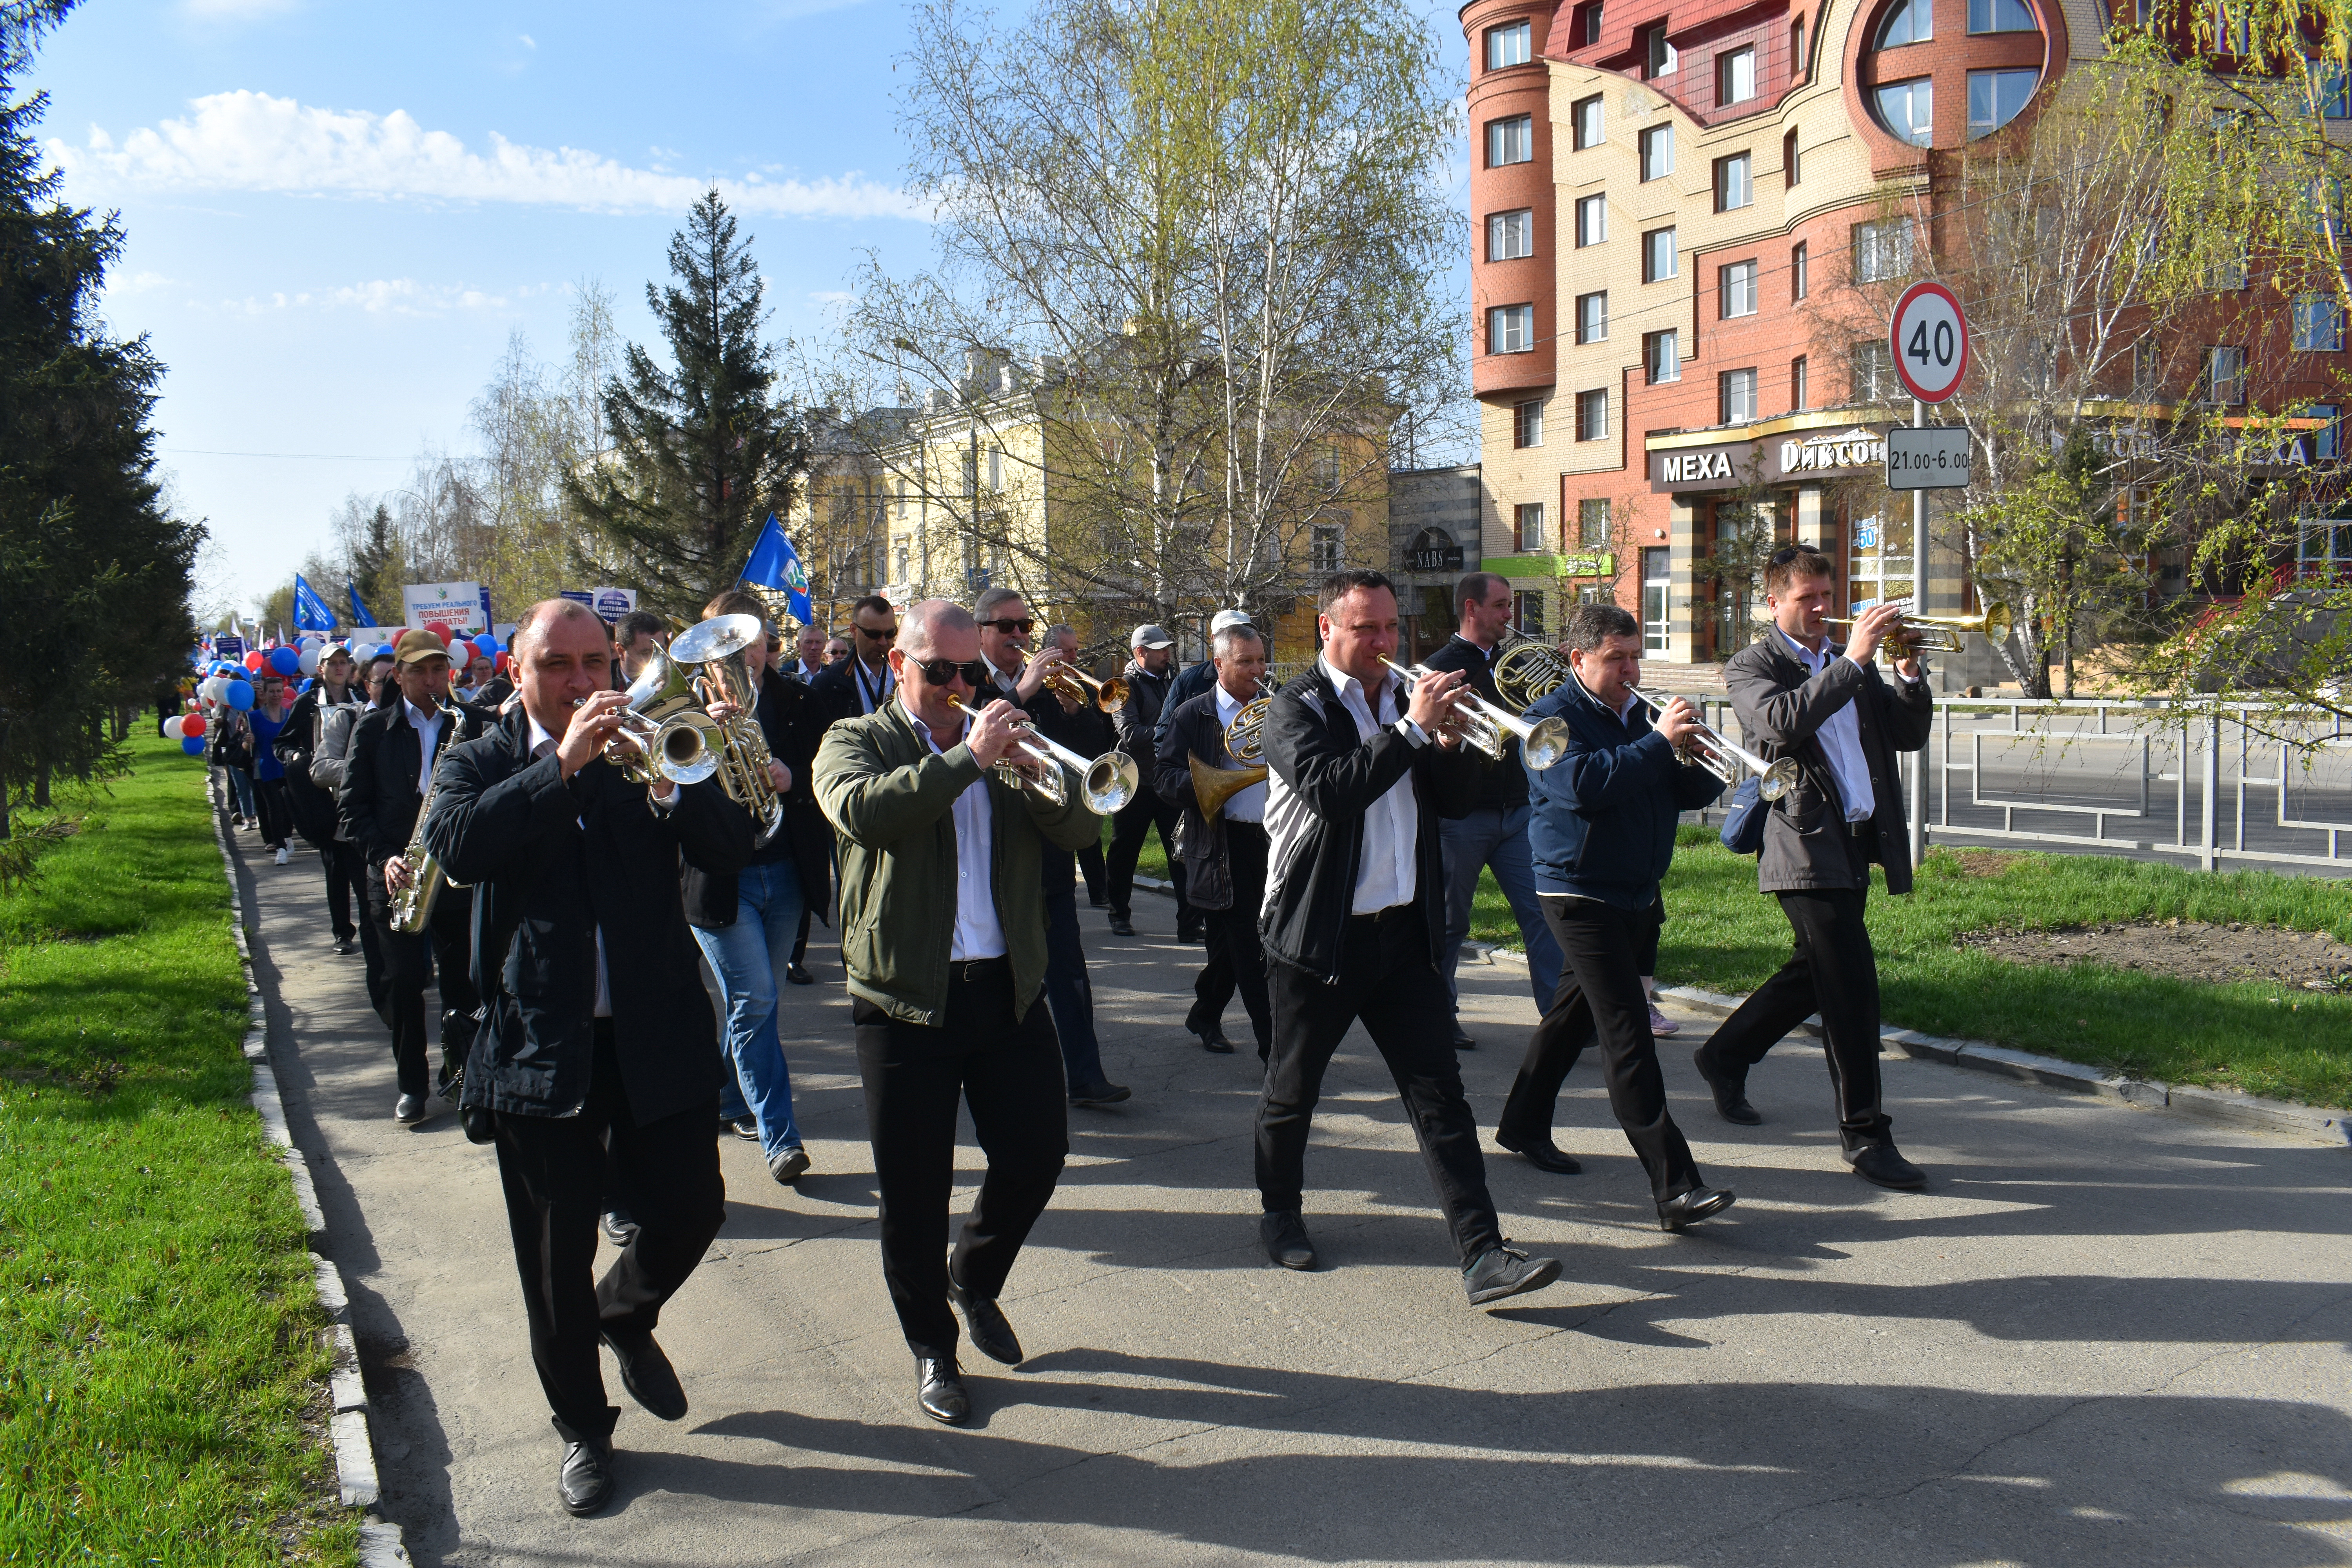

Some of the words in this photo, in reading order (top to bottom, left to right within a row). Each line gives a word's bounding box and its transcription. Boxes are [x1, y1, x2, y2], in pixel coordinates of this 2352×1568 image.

[1908, 320, 1954, 367] 40
[1663, 452, 1733, 482] МЕХА
[1417, 550, 1443, 568] NABS
[418, 608, 470, 619] ПОВЫШЕНИЯ
